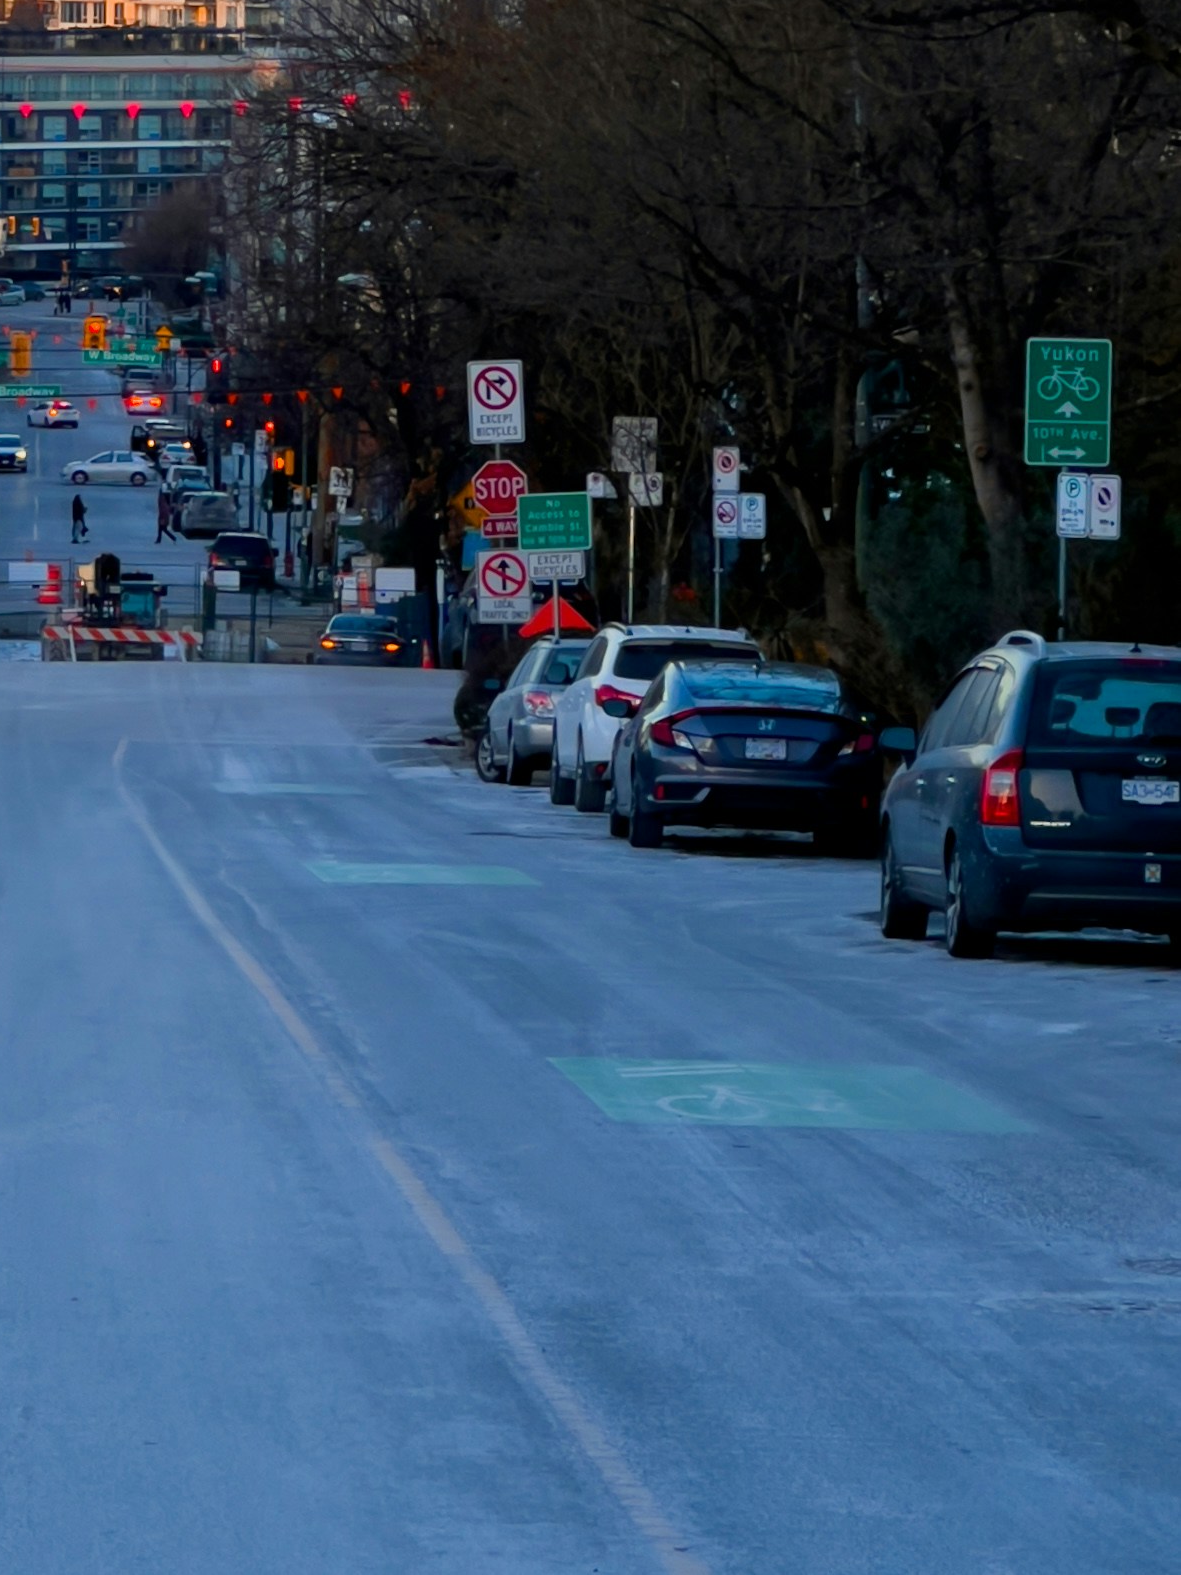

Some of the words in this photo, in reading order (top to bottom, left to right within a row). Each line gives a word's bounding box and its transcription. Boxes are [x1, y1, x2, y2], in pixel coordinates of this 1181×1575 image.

[89, 351, 100, 360] W
[103, 351, 156, 363] Broadway
[1041, 346, 1099, 361] Yukon
[479, 414, 513, 425] EXCEPT
[476, 425, 518, 437] BICYCLES
[475, 476, 524, 499] STOP
[546, 499, 561, 508] No
[528, 510, 564, 520] Access
[568, 509, 580, 518] to
[484, 522, 493, 532] 4
[496, 521, 518, 532] WAY
[524, 523, 565, 533] Cambie
[537, 554, 573, 565] EXCEPT
[533, 565, 578, 576] BICYCLES
[493, 600, 515, 609] LOCAL
[481, 609, 510, 620] TRAFFIC
[512, 610, 529, 620] ONLY
